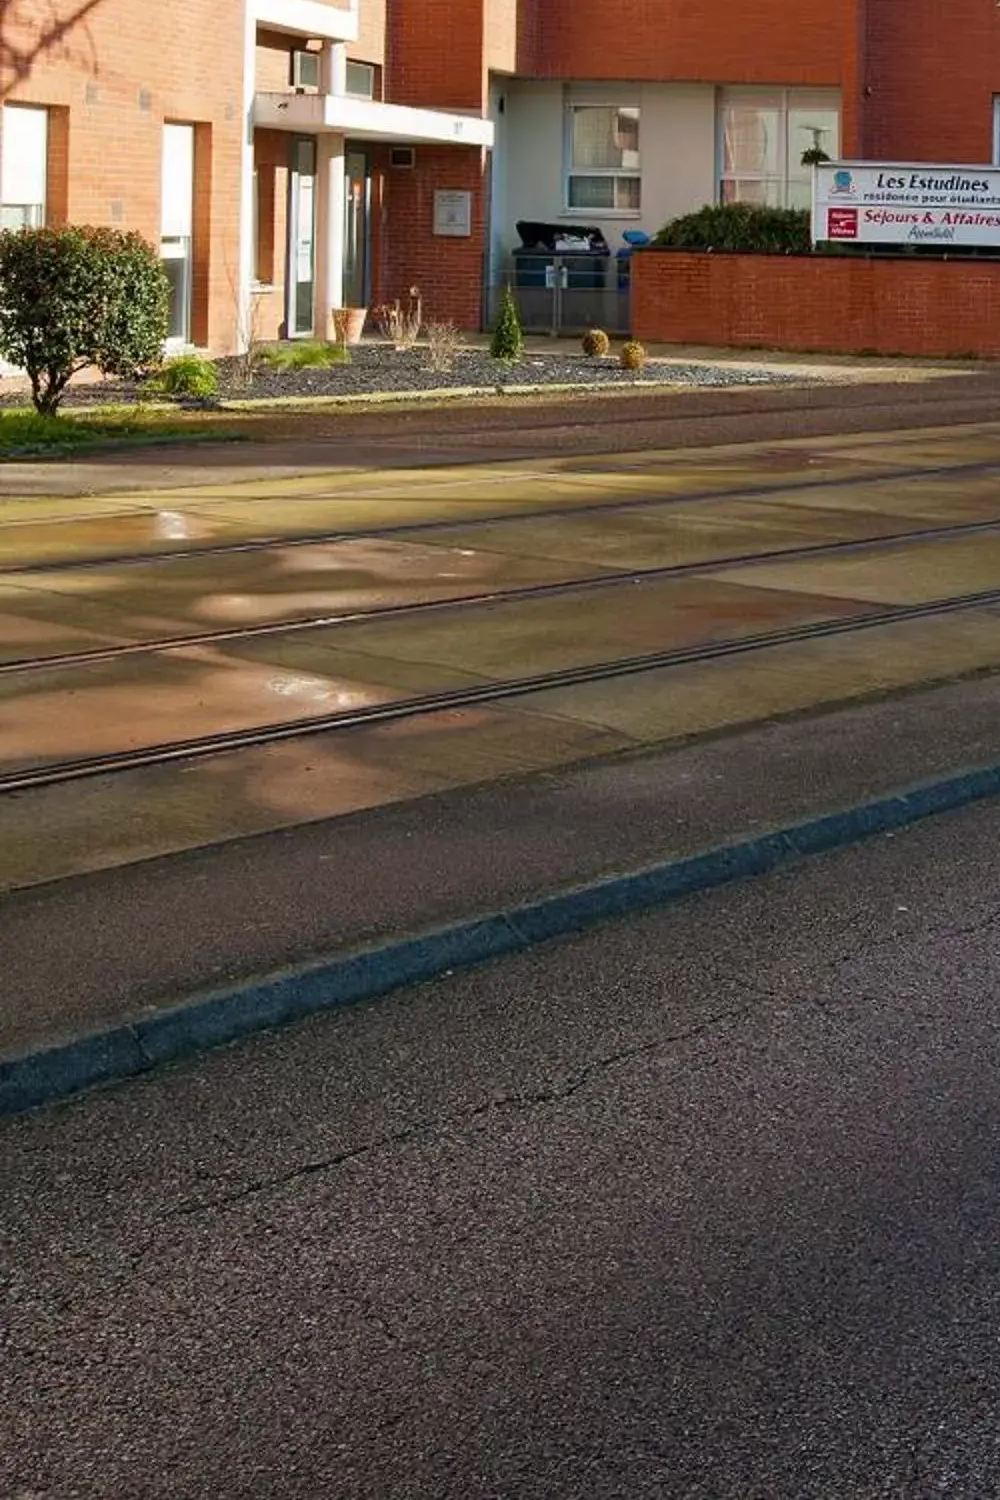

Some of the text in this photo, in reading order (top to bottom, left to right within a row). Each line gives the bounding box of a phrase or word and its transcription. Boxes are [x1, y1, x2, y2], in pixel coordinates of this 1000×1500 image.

[877, 173, 990, 192] Les Estudines
[922, 194, 948, 203] pour
[863, 209, 918, 225] Séjours
[921, 211, 935, 225] &
